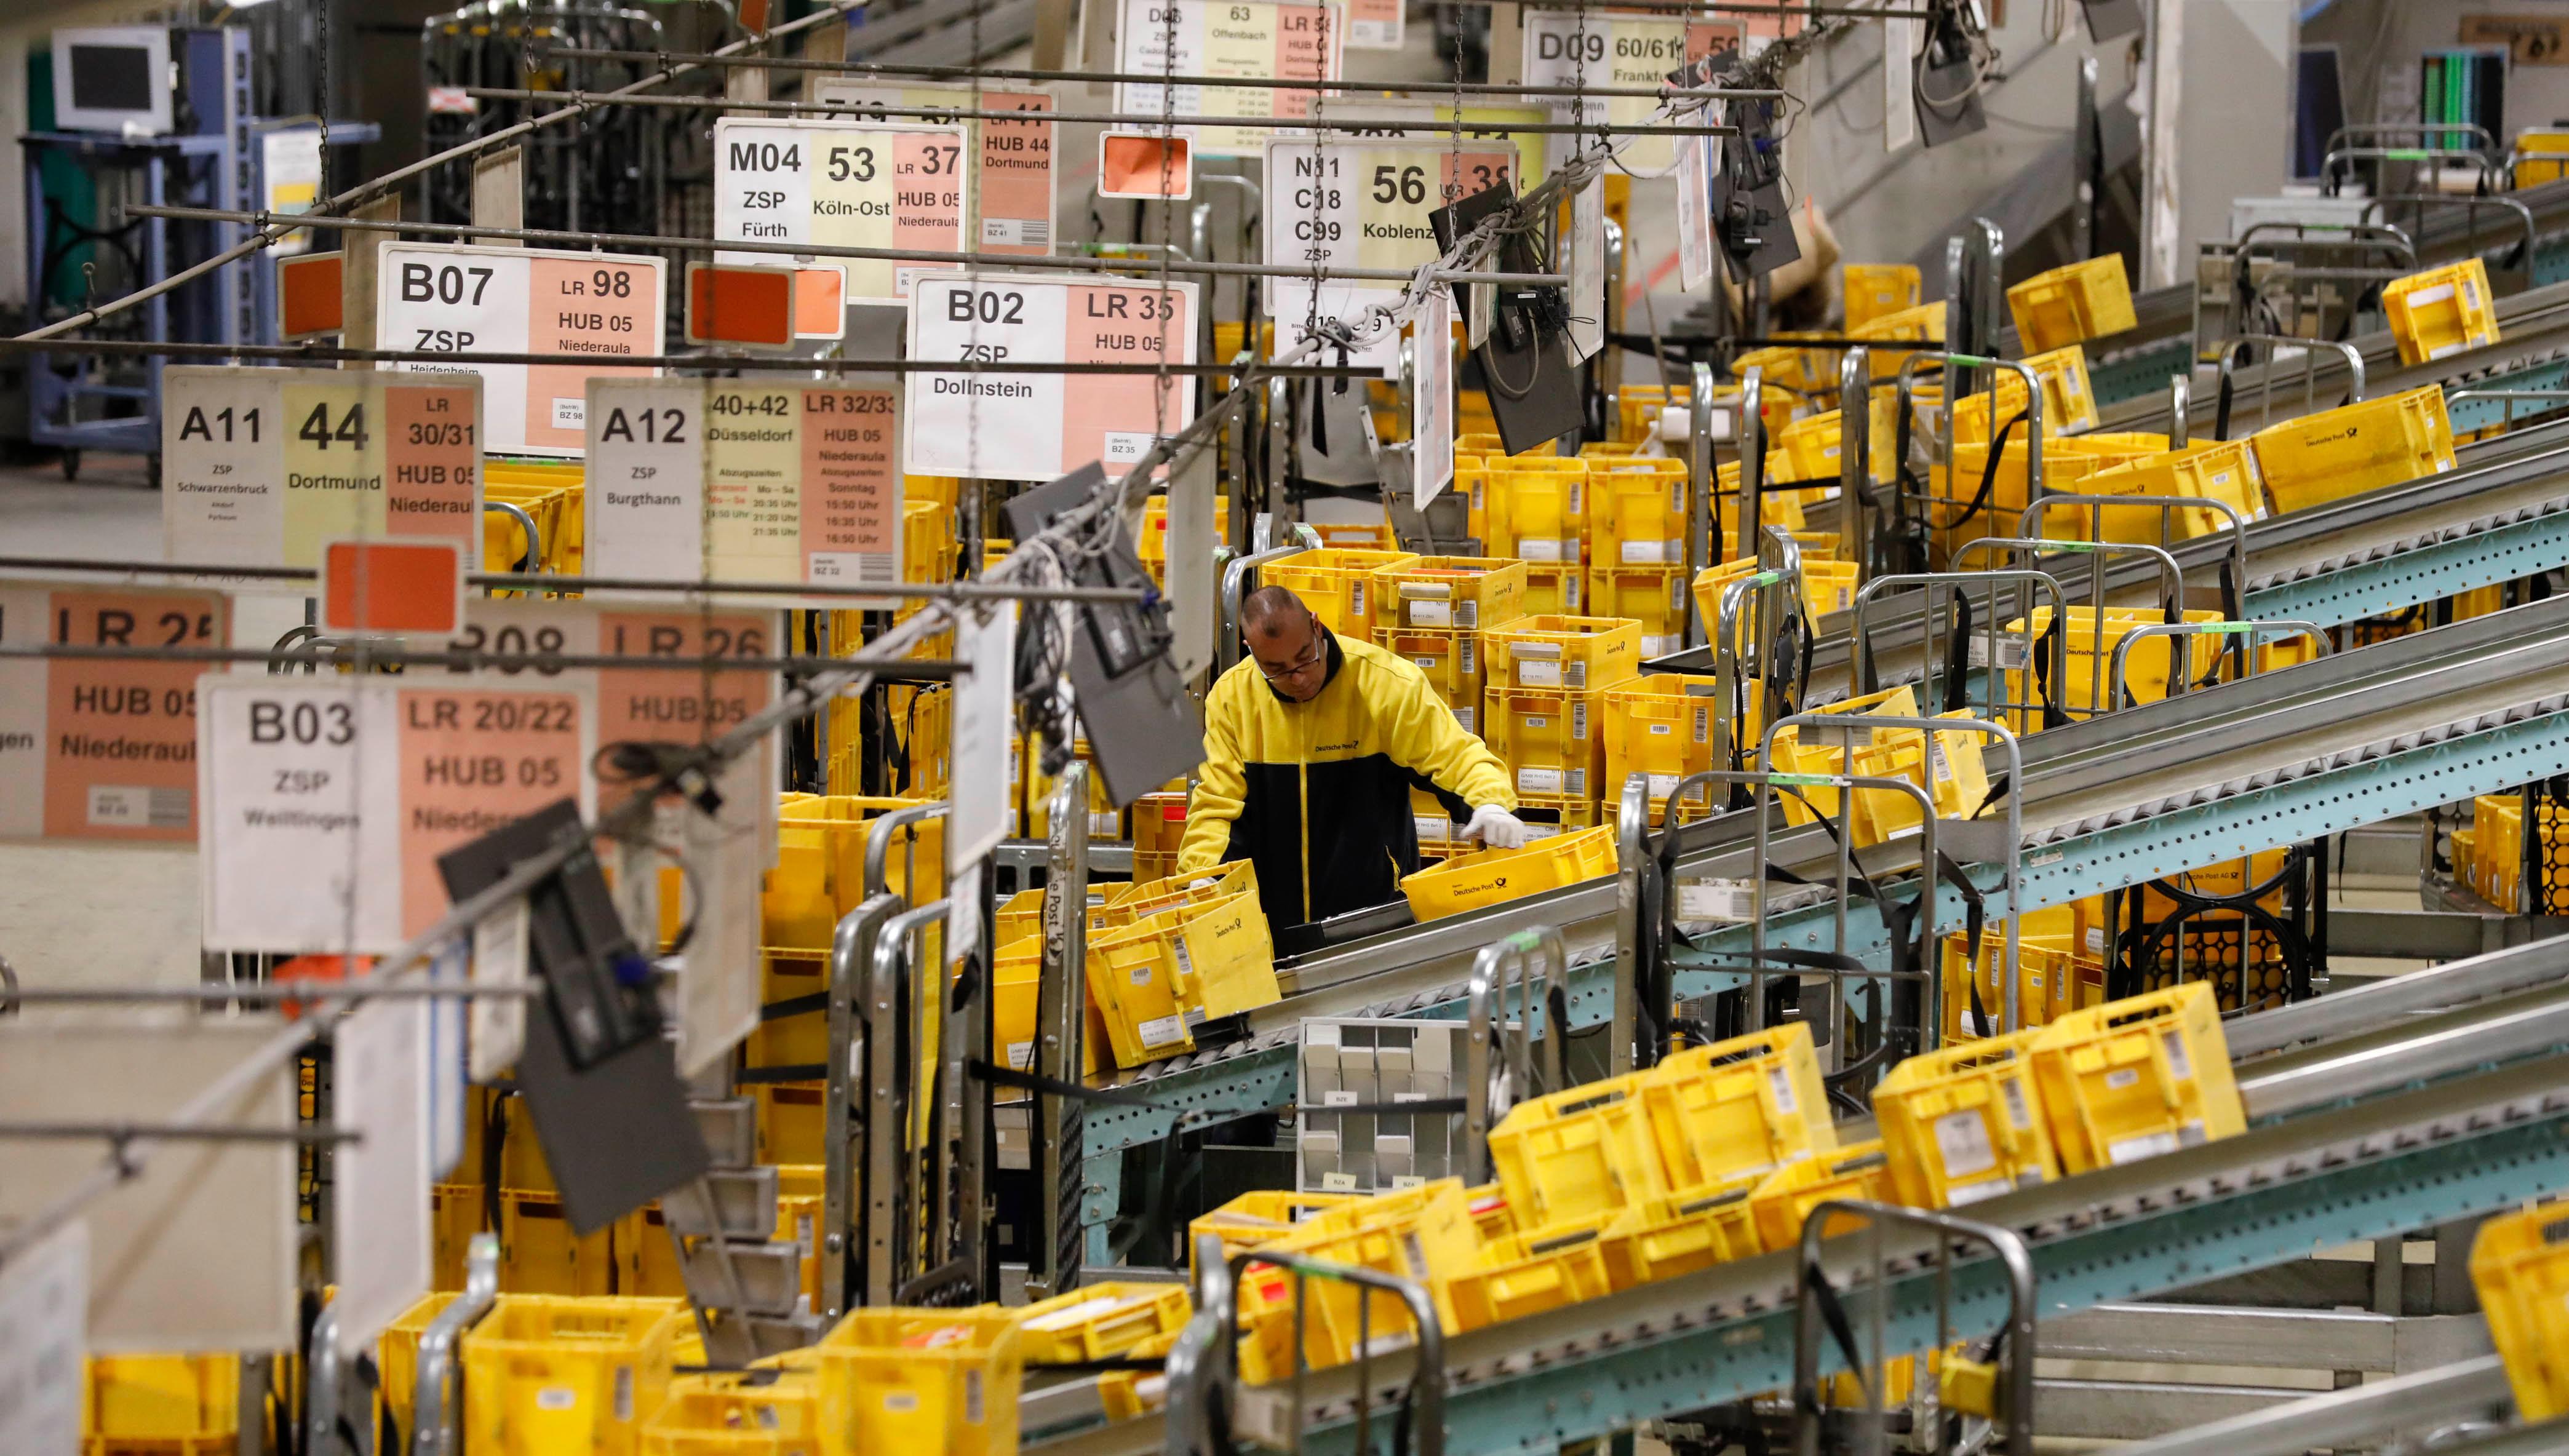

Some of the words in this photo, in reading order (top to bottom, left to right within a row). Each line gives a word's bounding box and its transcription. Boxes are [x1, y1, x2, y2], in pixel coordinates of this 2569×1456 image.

[1230, 6, 1250, 22] 63
[1284, 16, 1308, 31] LR
[1212, 28, 1267, 41] Offenbach
[1288, 40, 1312, 50] HUB
[1539, 32, 1604, 62] D09
[1616, 38, 1676, 58] 60/61
[986, 136, 1024, 151] HUB
[1030, 138, 1050, 153] 44
[730, 143, 801, 173] M04
[828, 146, 875, 182] 53
[897, 163, 914, 174] LR
[922, 145, 960, 175] 37
[986, 156, 1049, 170] Dortmund
[1296, 156, 1339, 178] N11
[1372, 164, 1426, 205] 56
[743, 191, 786, 209] ZSP
[813, 200, 891, 216] Köln-Ost
[898, 191, 936, 207] HUB
[942, 193, 960, 207] 05
[1295, 188, 1341, 210] C18
[742, 222, 787, 237] Fürth
[1295, 221, 1341, 242] C99
[1363, 223, 1435, 240] Koblenz
[1304, 249, 1332, 261] ZSP
[400, 263, 493, 306] B07
[560, 280, 584, 296] LR
[593, 269, 631, 298] 98
[948, 288, 1024, 324] B02
[1088, 292, 1128, 319] LR
[1139, 295, 1174, 320] 35
[559, 312, 603, 331] HUB
[610, 315, 632, 333] 05
[414, 329, 475, 353] ZSP
[559, 339, 631, 354] Niederaula
[1096, 333, 1136, 351] HUB
[1142, 336, 1162, 352] 05
[960, 344, 1008, 364] ZSP
[410, 364, 479, 376] Heidenheim
[934, 377, 1033, 399] Dollnstein
[426, 399, 448, 412] LR
[712, 394, 789, 416] 40+42
[807, 395, 834, 413] LR
[179, 406, 260, 443] A11
[573, 412, 583, 420] 98
[299, 402, 369, 451] 44
[408, 423, 474, 445] 30/31
[601, 408, 685, 444] A12
[709, 428, 793, 442] Düsseldorf
[824, 429, 857, 442] HUB
[861, 429, 880, 442] 05
[819, 450, 886, 462] Niederaula
[212, 464, 233, 474] ZSP
[397, 466, 446, 485] HUB
[631, 467, 656, 479] ZSP
[719, 469, 782, 479] Abzugszeiten
[821, 467, 884, 477] Abzugszeiten
[177, 482, 269, 495] Schwarzenbruck
[289, 472, 380, 491] Dortmund
[828, 482, 877, 495] Sonntag
[607, 492, 681, 507] Burgthann
[859, 499, 879, 510] Uhr
[859, 517, 879, 527] Uhr
[859, 534, 879, 544] Uhr
[73, 685, 151, 716] HUB
[629, 696, 698, 723] HUB
[706, 697, 747, 723] 05
[250, 701, 356, 746] B03
[408, 699, 460, 730] LR
[474, 701, 573, 733] 20/22
[1315, 743, 1341, 752] Deutsche
[424, 757, 506, 787] HUB
[517, 758, 560, 787] 05
[273, 770, 330, 794] ZSP
[1453, 886, 1481, 897] Deutsche
[1048, 896, 1061, 926] Post
